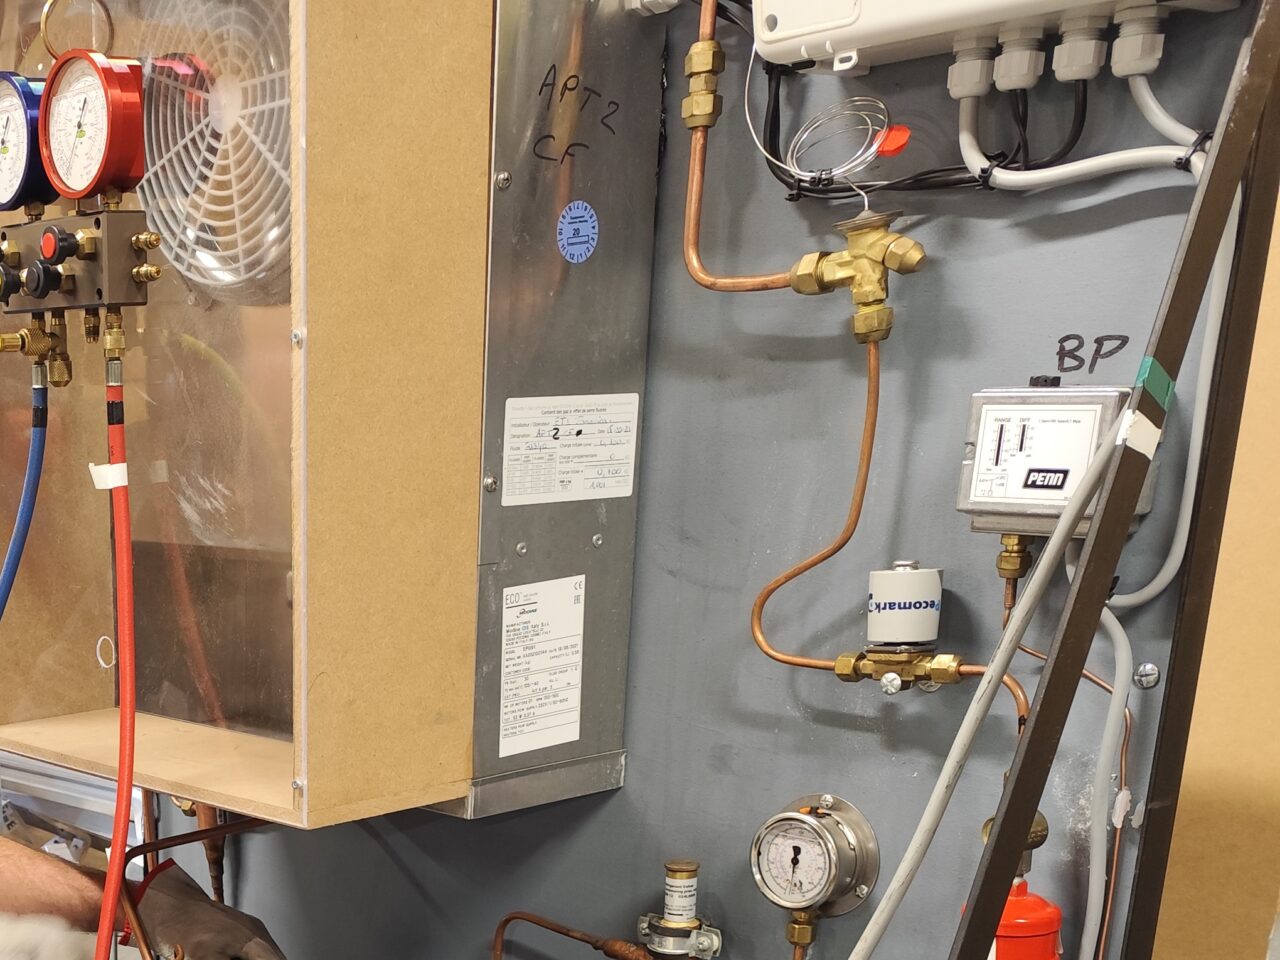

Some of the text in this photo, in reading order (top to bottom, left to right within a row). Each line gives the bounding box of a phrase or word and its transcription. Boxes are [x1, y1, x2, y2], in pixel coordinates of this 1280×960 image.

[538, 63, 620, 135] APT 2
[533, 134, 590, 165] CF
[1056, 333, 1130, 375] BP
[1027, 472, 1065, 486] PENN
[505, 592, 520, 606] ECO
